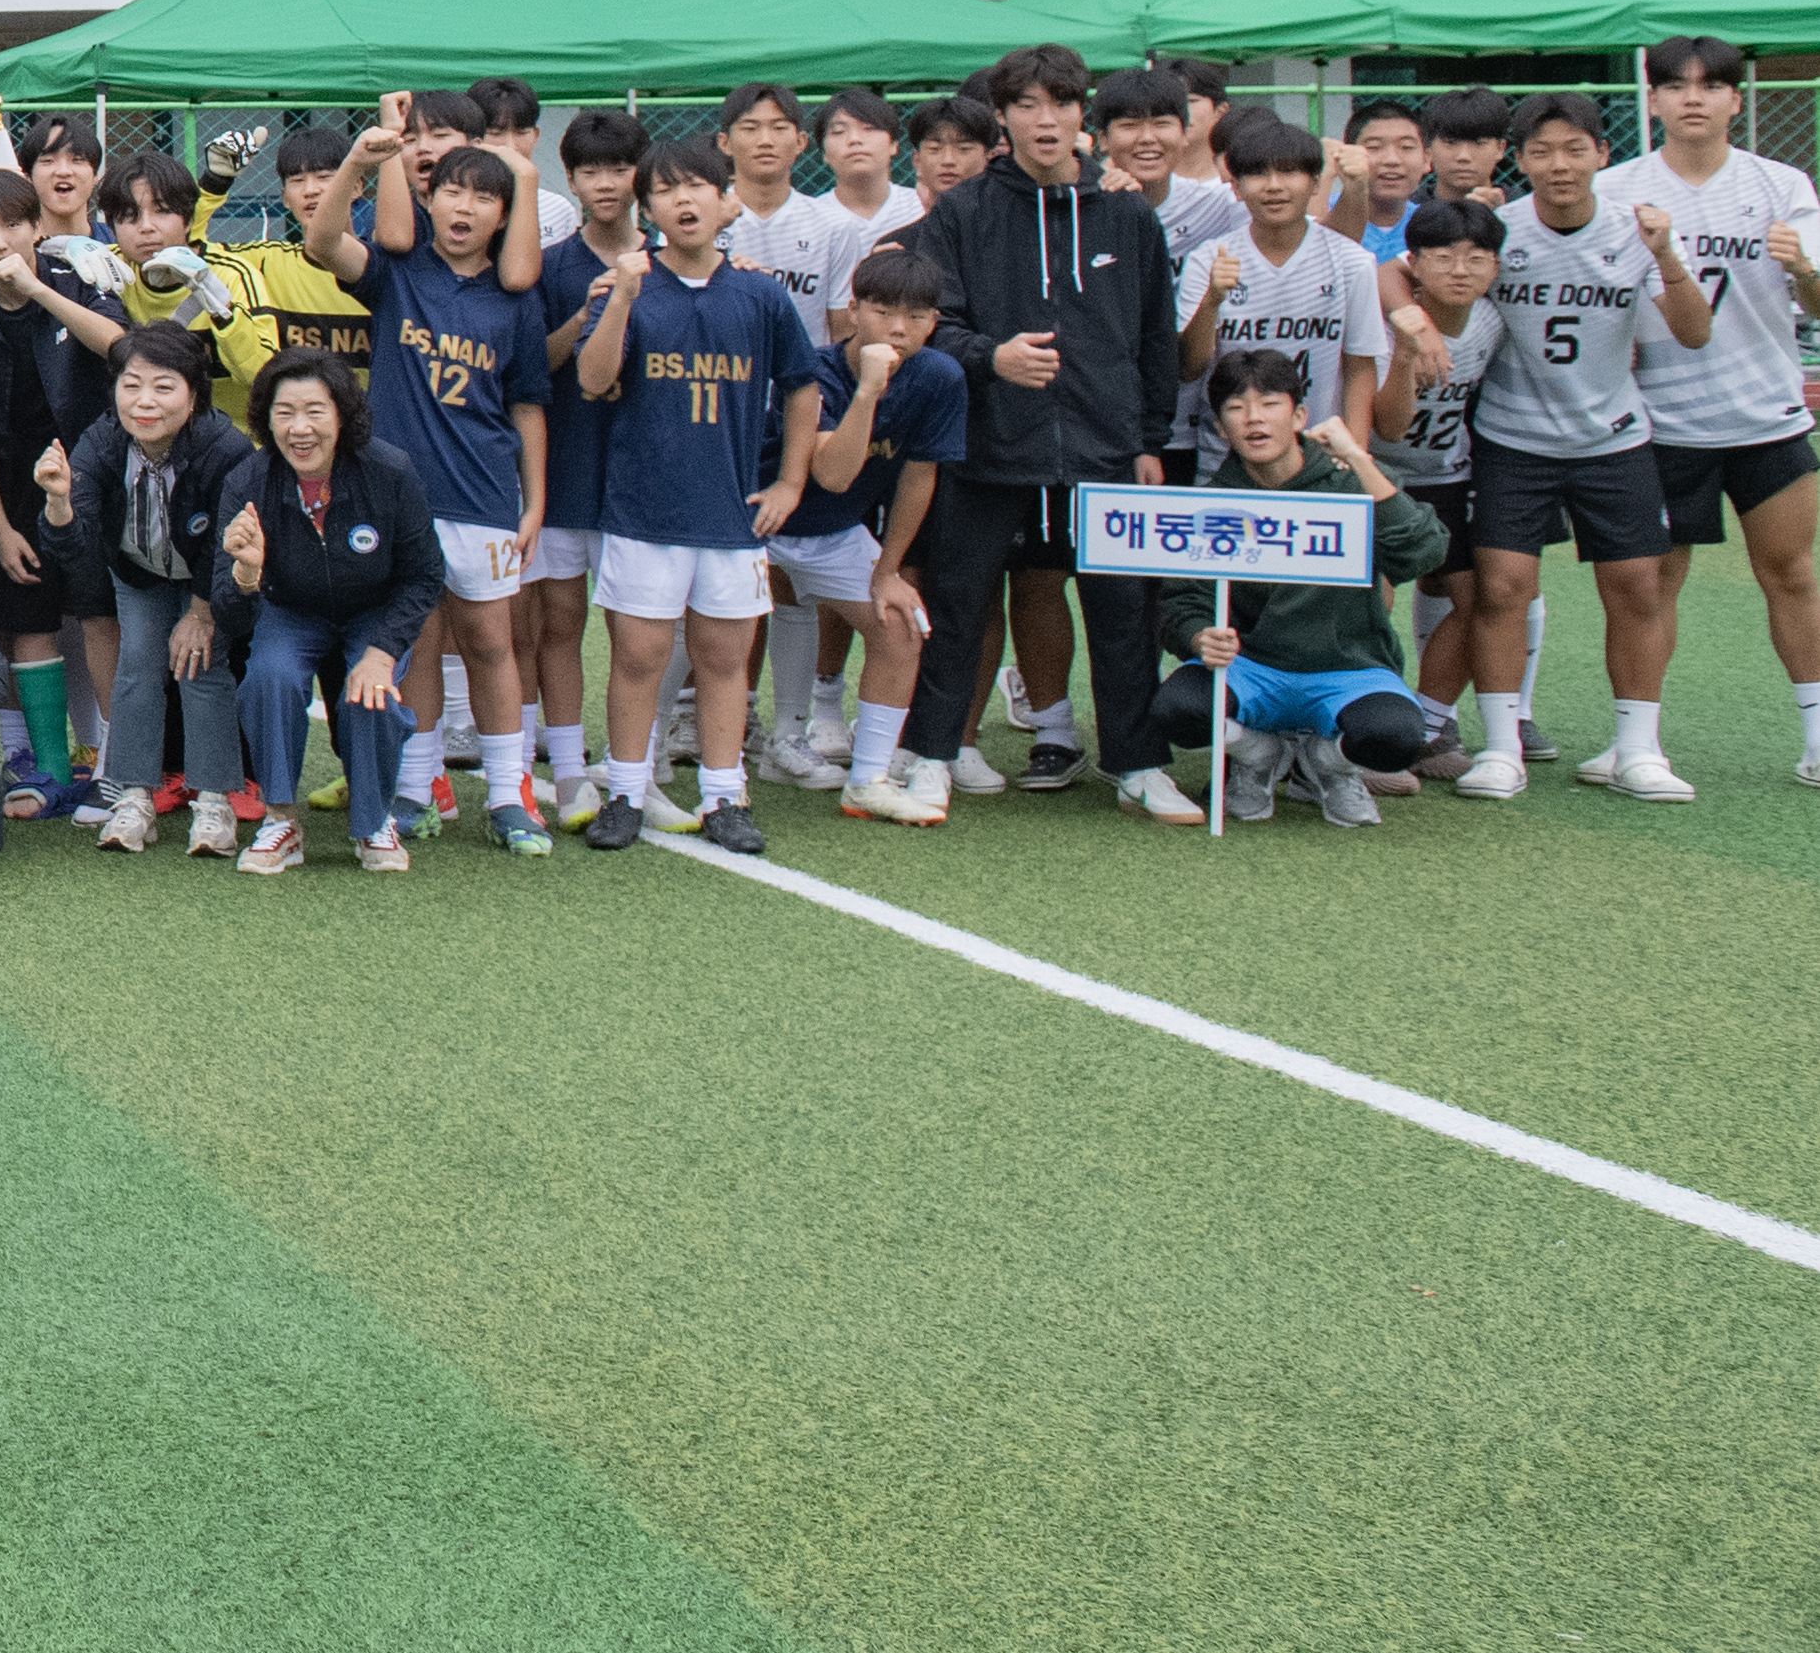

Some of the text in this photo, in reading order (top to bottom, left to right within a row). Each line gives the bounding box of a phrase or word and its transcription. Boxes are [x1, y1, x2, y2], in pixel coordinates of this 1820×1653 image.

[1696, 235, 1762, 261] DONG
[1496, 283, 1634, 309] HAE DONG
[1698, 266, 1731, 316] 7
[399, 318, 496, 372] BS.NAM
[1220, 316, 1342, 341] HAE DONG
[1544, 315, 1581, 365] 5
[427, 360, 470, 407] 12
[646, 352, 752, 382] BS.NAM
[689, 382, 719, 425] 11
[1403, 408, 1465, 450] 42
[1105, 509, 1345, 557] 해동중학교
